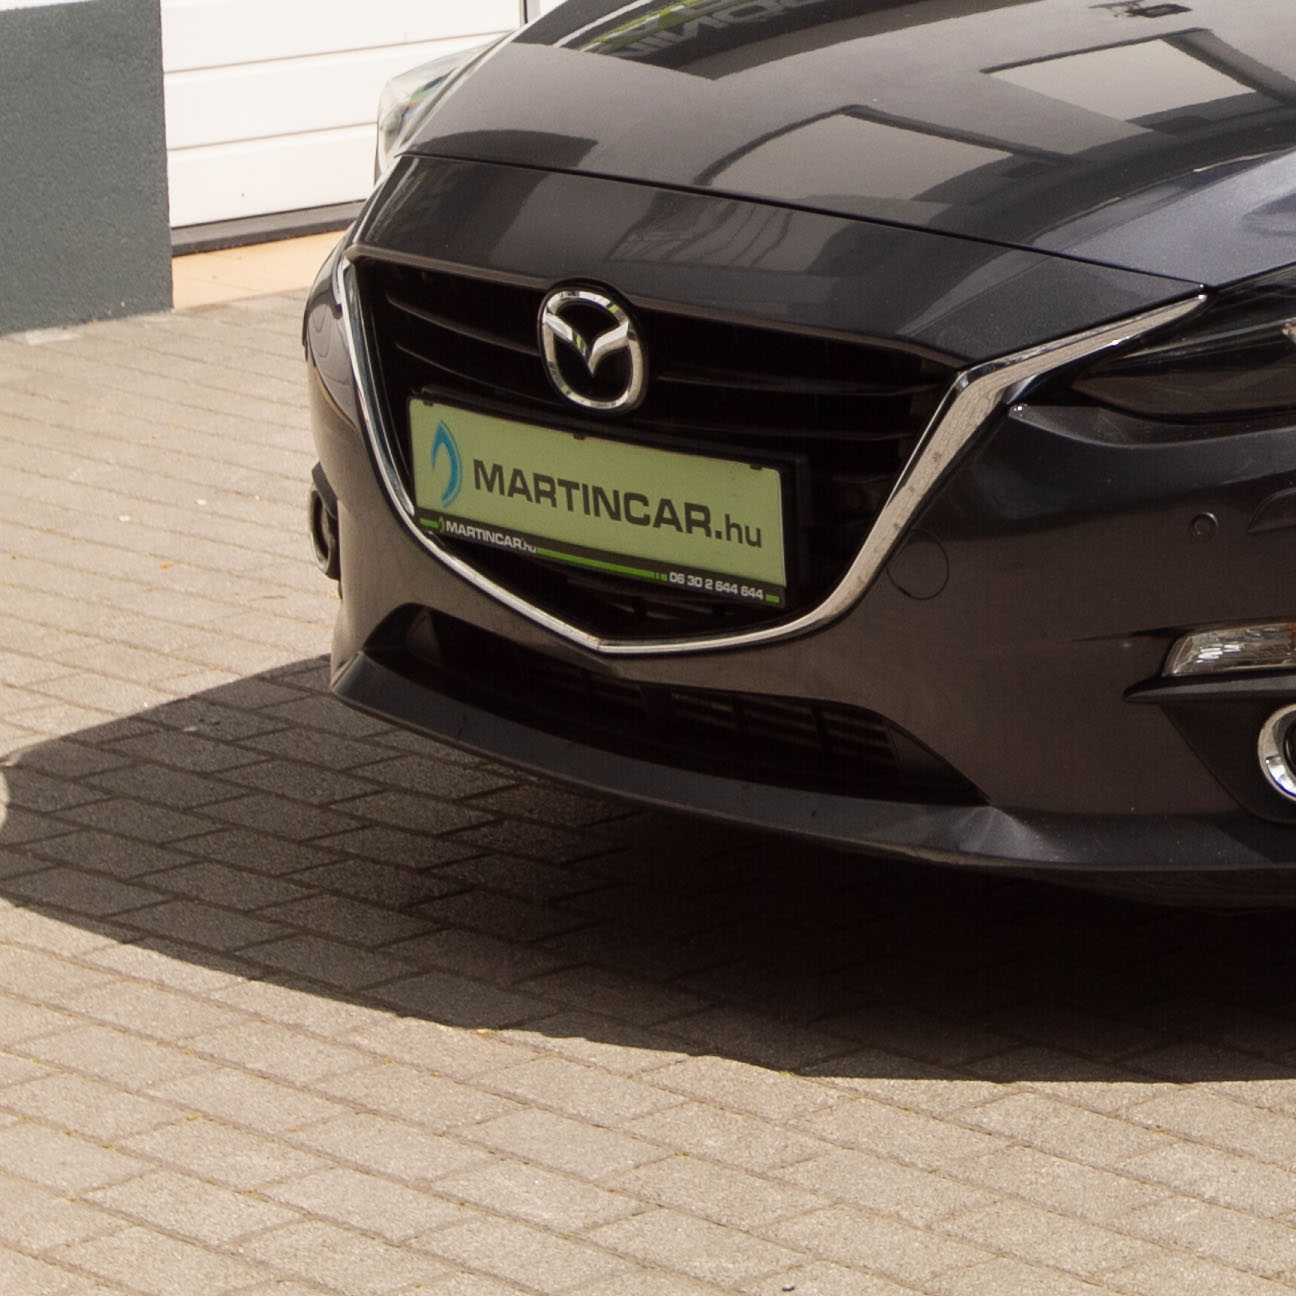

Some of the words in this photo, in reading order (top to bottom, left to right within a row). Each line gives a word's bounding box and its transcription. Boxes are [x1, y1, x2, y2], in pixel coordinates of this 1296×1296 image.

[473, 459, 763, 549] MARTINCAR.hu
[446, 520, 537, 553] MARTINCAR.hu
[669, 571, 685, 585] 06
[687, 575, 702, 588] 30
[705, 578, 713, 590] 2
[715, 580, 738, 595] 644
[741, 585, 764, 600] 644
